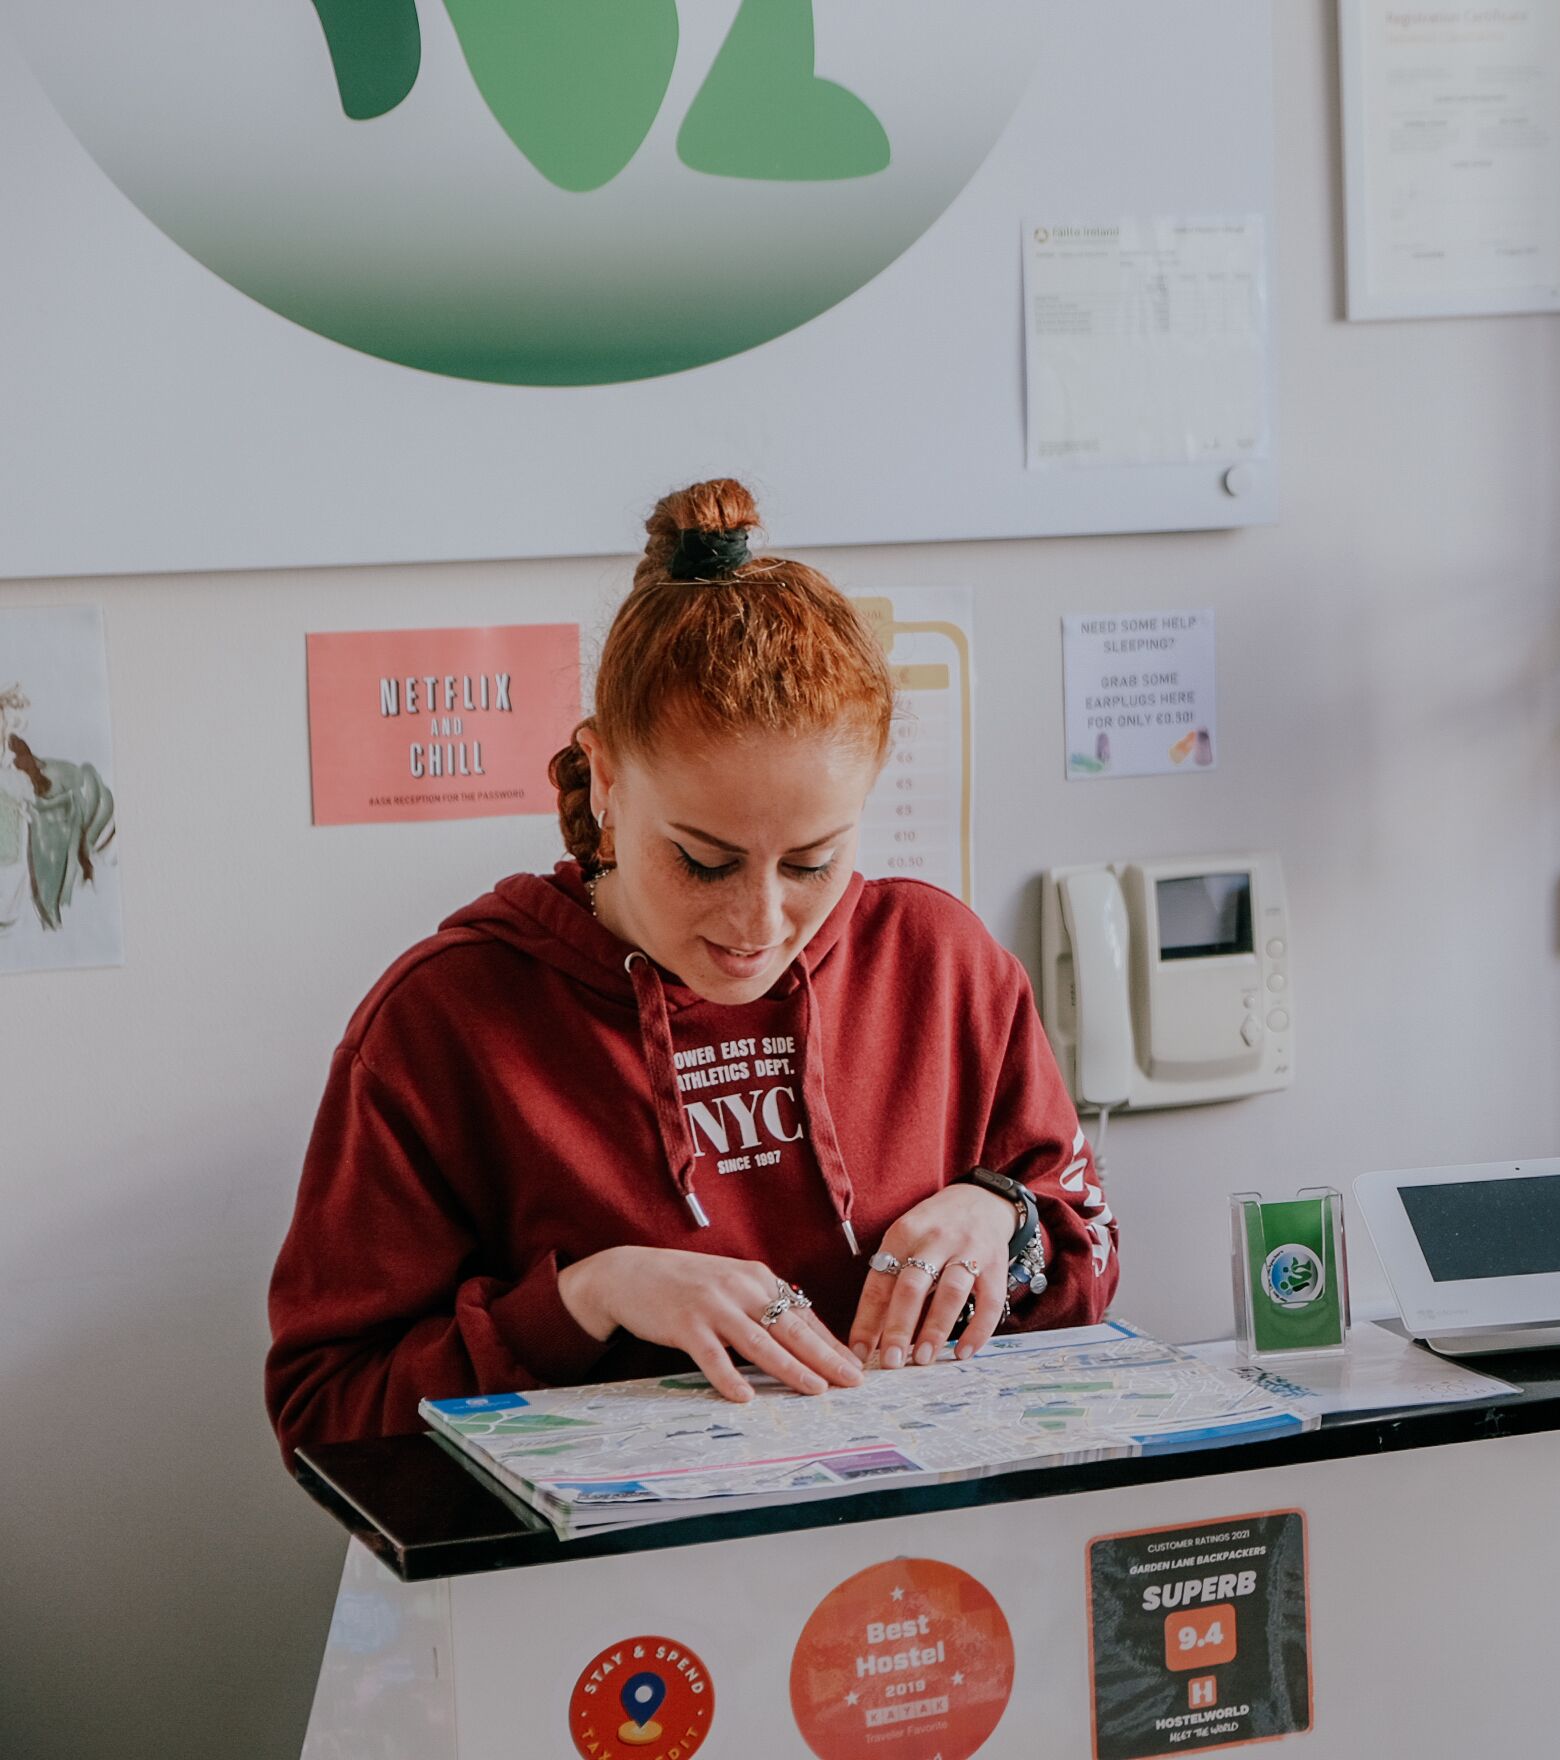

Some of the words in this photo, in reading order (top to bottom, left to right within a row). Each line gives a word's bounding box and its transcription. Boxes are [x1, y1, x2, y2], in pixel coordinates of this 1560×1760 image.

[1080, 620, 1117, 635] NEED
[1121, 618, 1158, 633] SOME
[1161, 616, 1196, 631] HELP
[1103, 636, 1175, 653] SLEEPING?
[1101, 672, 1138, 689] GRAB
[1141, 671, 1178, 687] SOME
[379, 672, 512, 717] NETFLIX
[1085, 693, 1156, 710] EARPLUGS
[1159, 691, 1195, 706] HERE
[430, 717, 464, 737] AND
[1087, 714, 1113, 729] FOR
[1117, 713, 1152, 728] ONLY
[409, 740, 486, 779] CHILL
[393, 794, 441, 805] RECEPTION
[442, 793, 459, 802] FOR
[461, 791, 475, 801] THE
[477, 789, 524, 801] PASSWORD
[673, 1046, 716, 1070] OWER
[720, 1038, 756, 1059] EAST
[762, 1036, 796, 1055] SIDE
[676, 1062, 750, 1092] ATHLETICS
[755, 1058, 795, 1077] DEPT.
[682, 1086, 804, 1158] NYC
[717, 1156, 752, 1175] SINCE
[1147, 1538, 1194, 1553] CUSTOMER
[1195, 1533, 1231, 1547] RATINGS
[1232, 1530, 1250, 1541] 2021
[1129, 1561, 1170, 1575] GARDEN
[1171, 1556, 1196, 1569] LANE
[1196, 1546, 1266, 1565] BACKPACKERS
[1142, 1570, 1257, 1611] SUPERB
[866, 1614, 930, 1645] Best
[1178, 1621, 1224, 1651] 9.4
[584, 1651, 623, 1695] STAY
[633, 1644, 645, 1658] &
[655, 1645, 705, 1694] SPEND
[855, 1641, 945, 1678] Hostel
[1192, 1680, 1213, 1704] H
[870, 1700, 944, 1723] KAYAK
[1156, 1704, 1250, 1730] HOSTELWORLD
[865, 1728, 905, 1744] Traveler
[906, 1720, 949, 1737] Favorite
[1169, 1728, 1192, 1744] MEET
[1194, 1726, 1209, 1738] THE
[1210, 1721, 1239, 1735] WORLD
